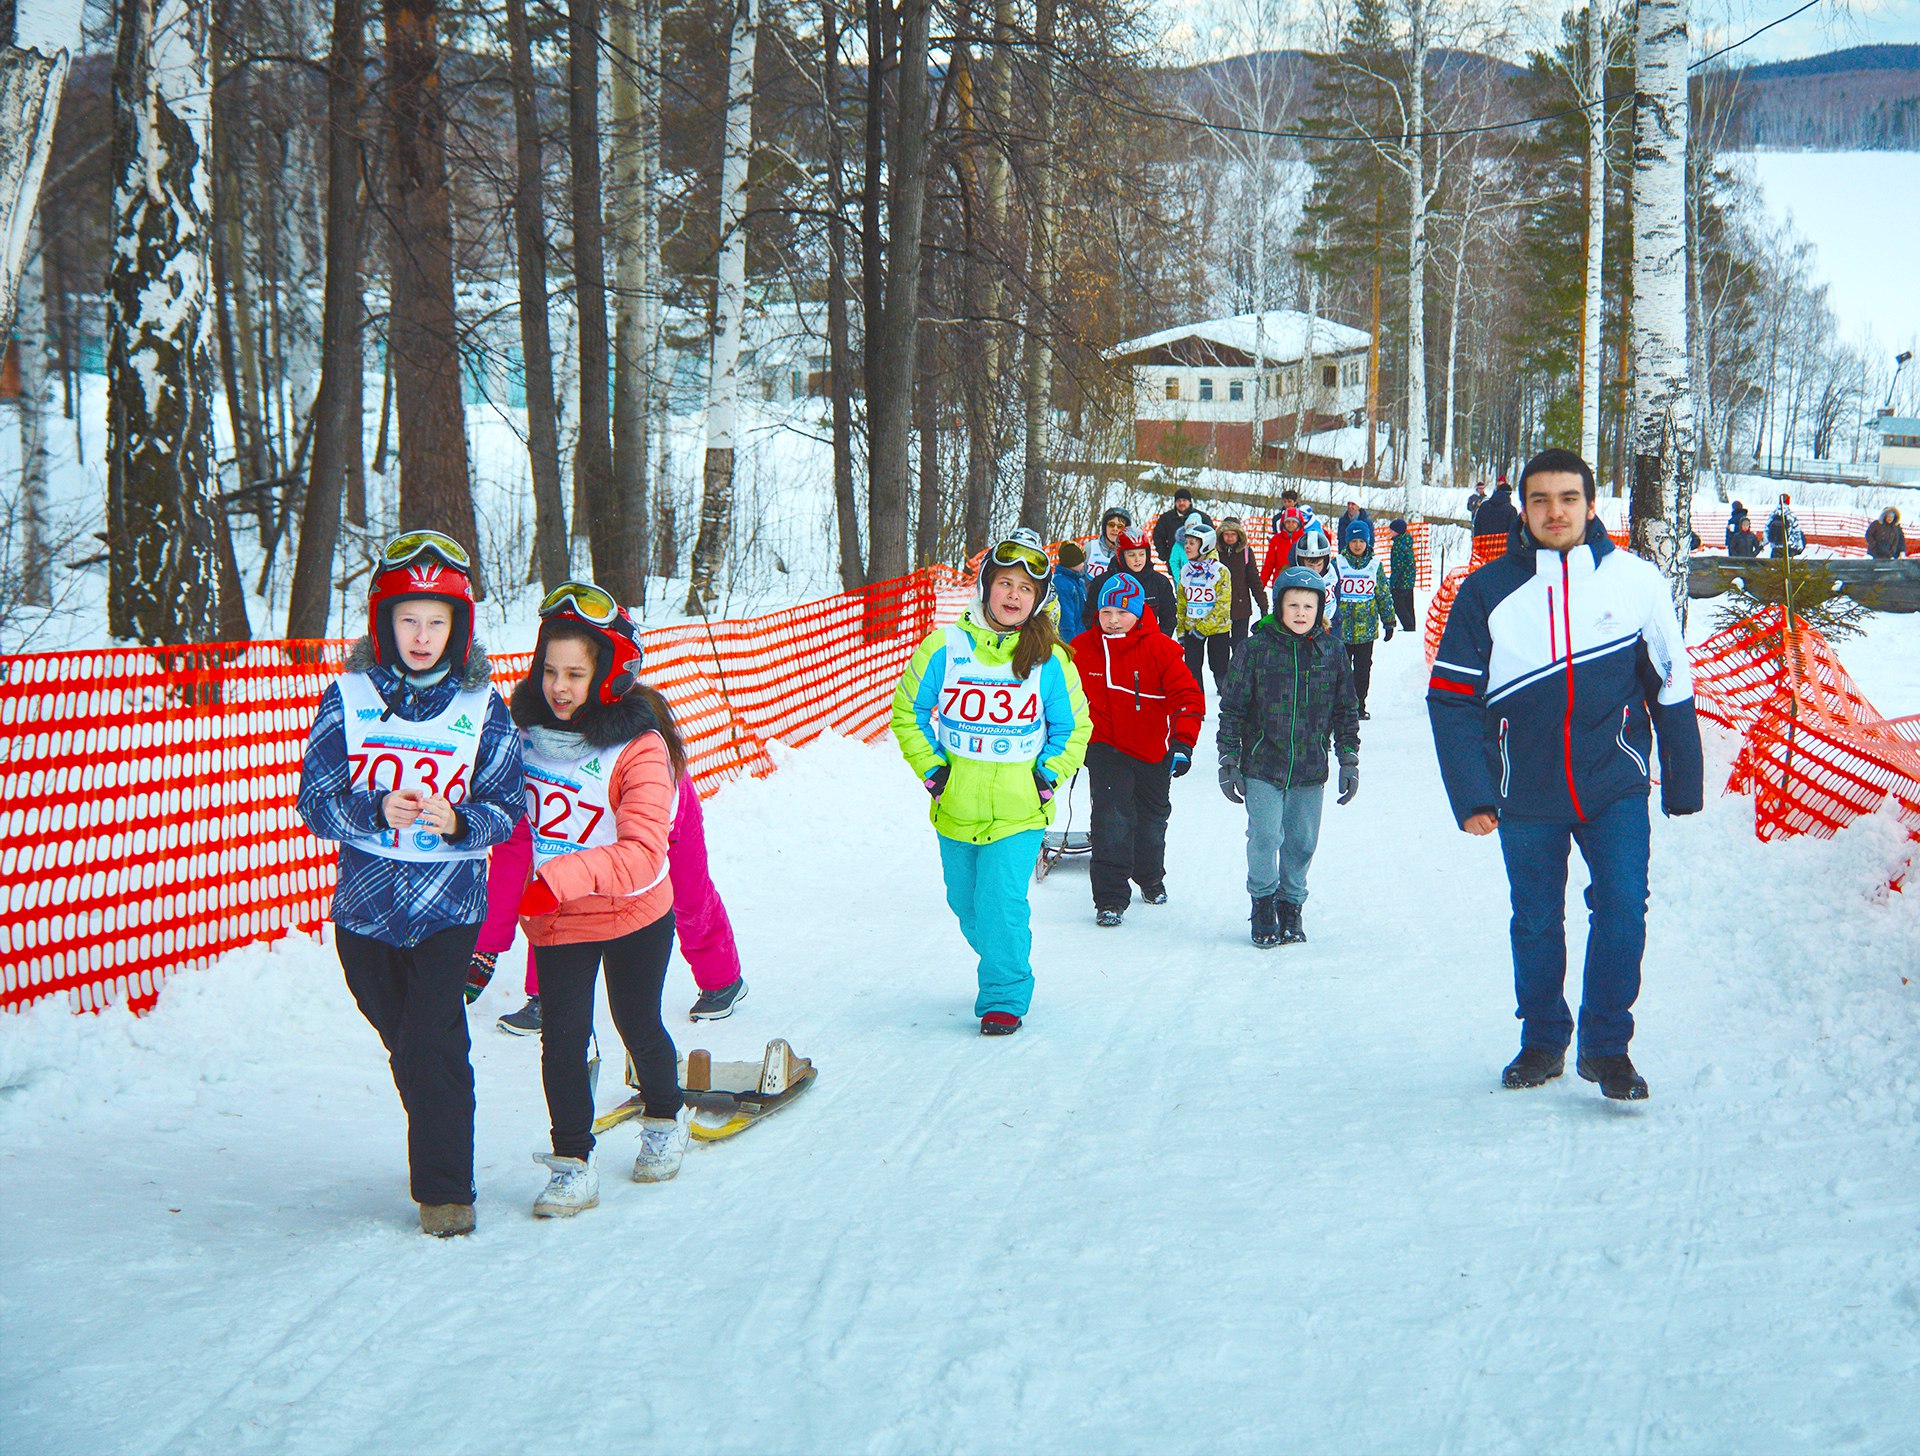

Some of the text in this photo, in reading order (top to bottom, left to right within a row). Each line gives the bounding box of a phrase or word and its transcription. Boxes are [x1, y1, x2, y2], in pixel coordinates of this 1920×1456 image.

[943, 688, 1038, 724] 7034
[958, 722, 1024, 735] Новоуральск
[347, 753, 470, 807] 7036
